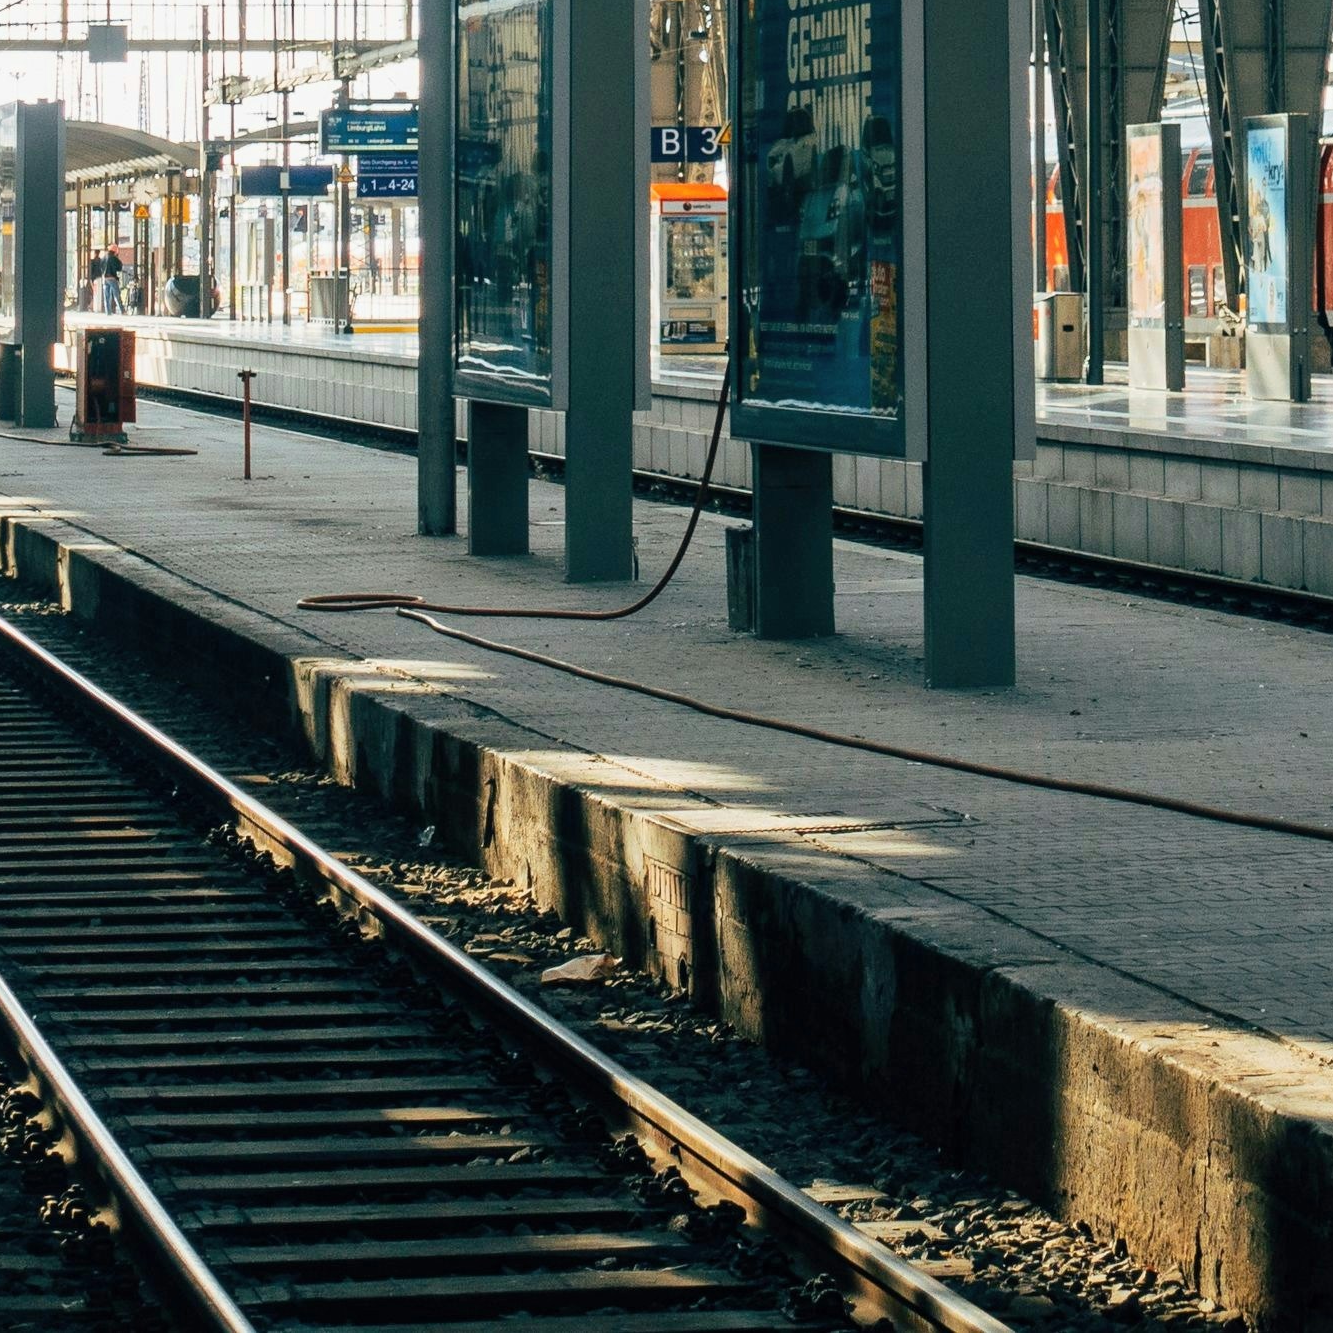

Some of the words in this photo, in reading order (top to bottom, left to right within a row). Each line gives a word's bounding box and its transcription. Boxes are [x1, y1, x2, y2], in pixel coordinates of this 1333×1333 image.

[787, 2, 872, 85] GEWINNE
[661, 128, 680, 155] B
[700, 128, 718, 155] 3
[370, 179, 376, 190] 1
[388, 179, 415, 191] 4-24
[1269, 161, 1283, 185] kry!
